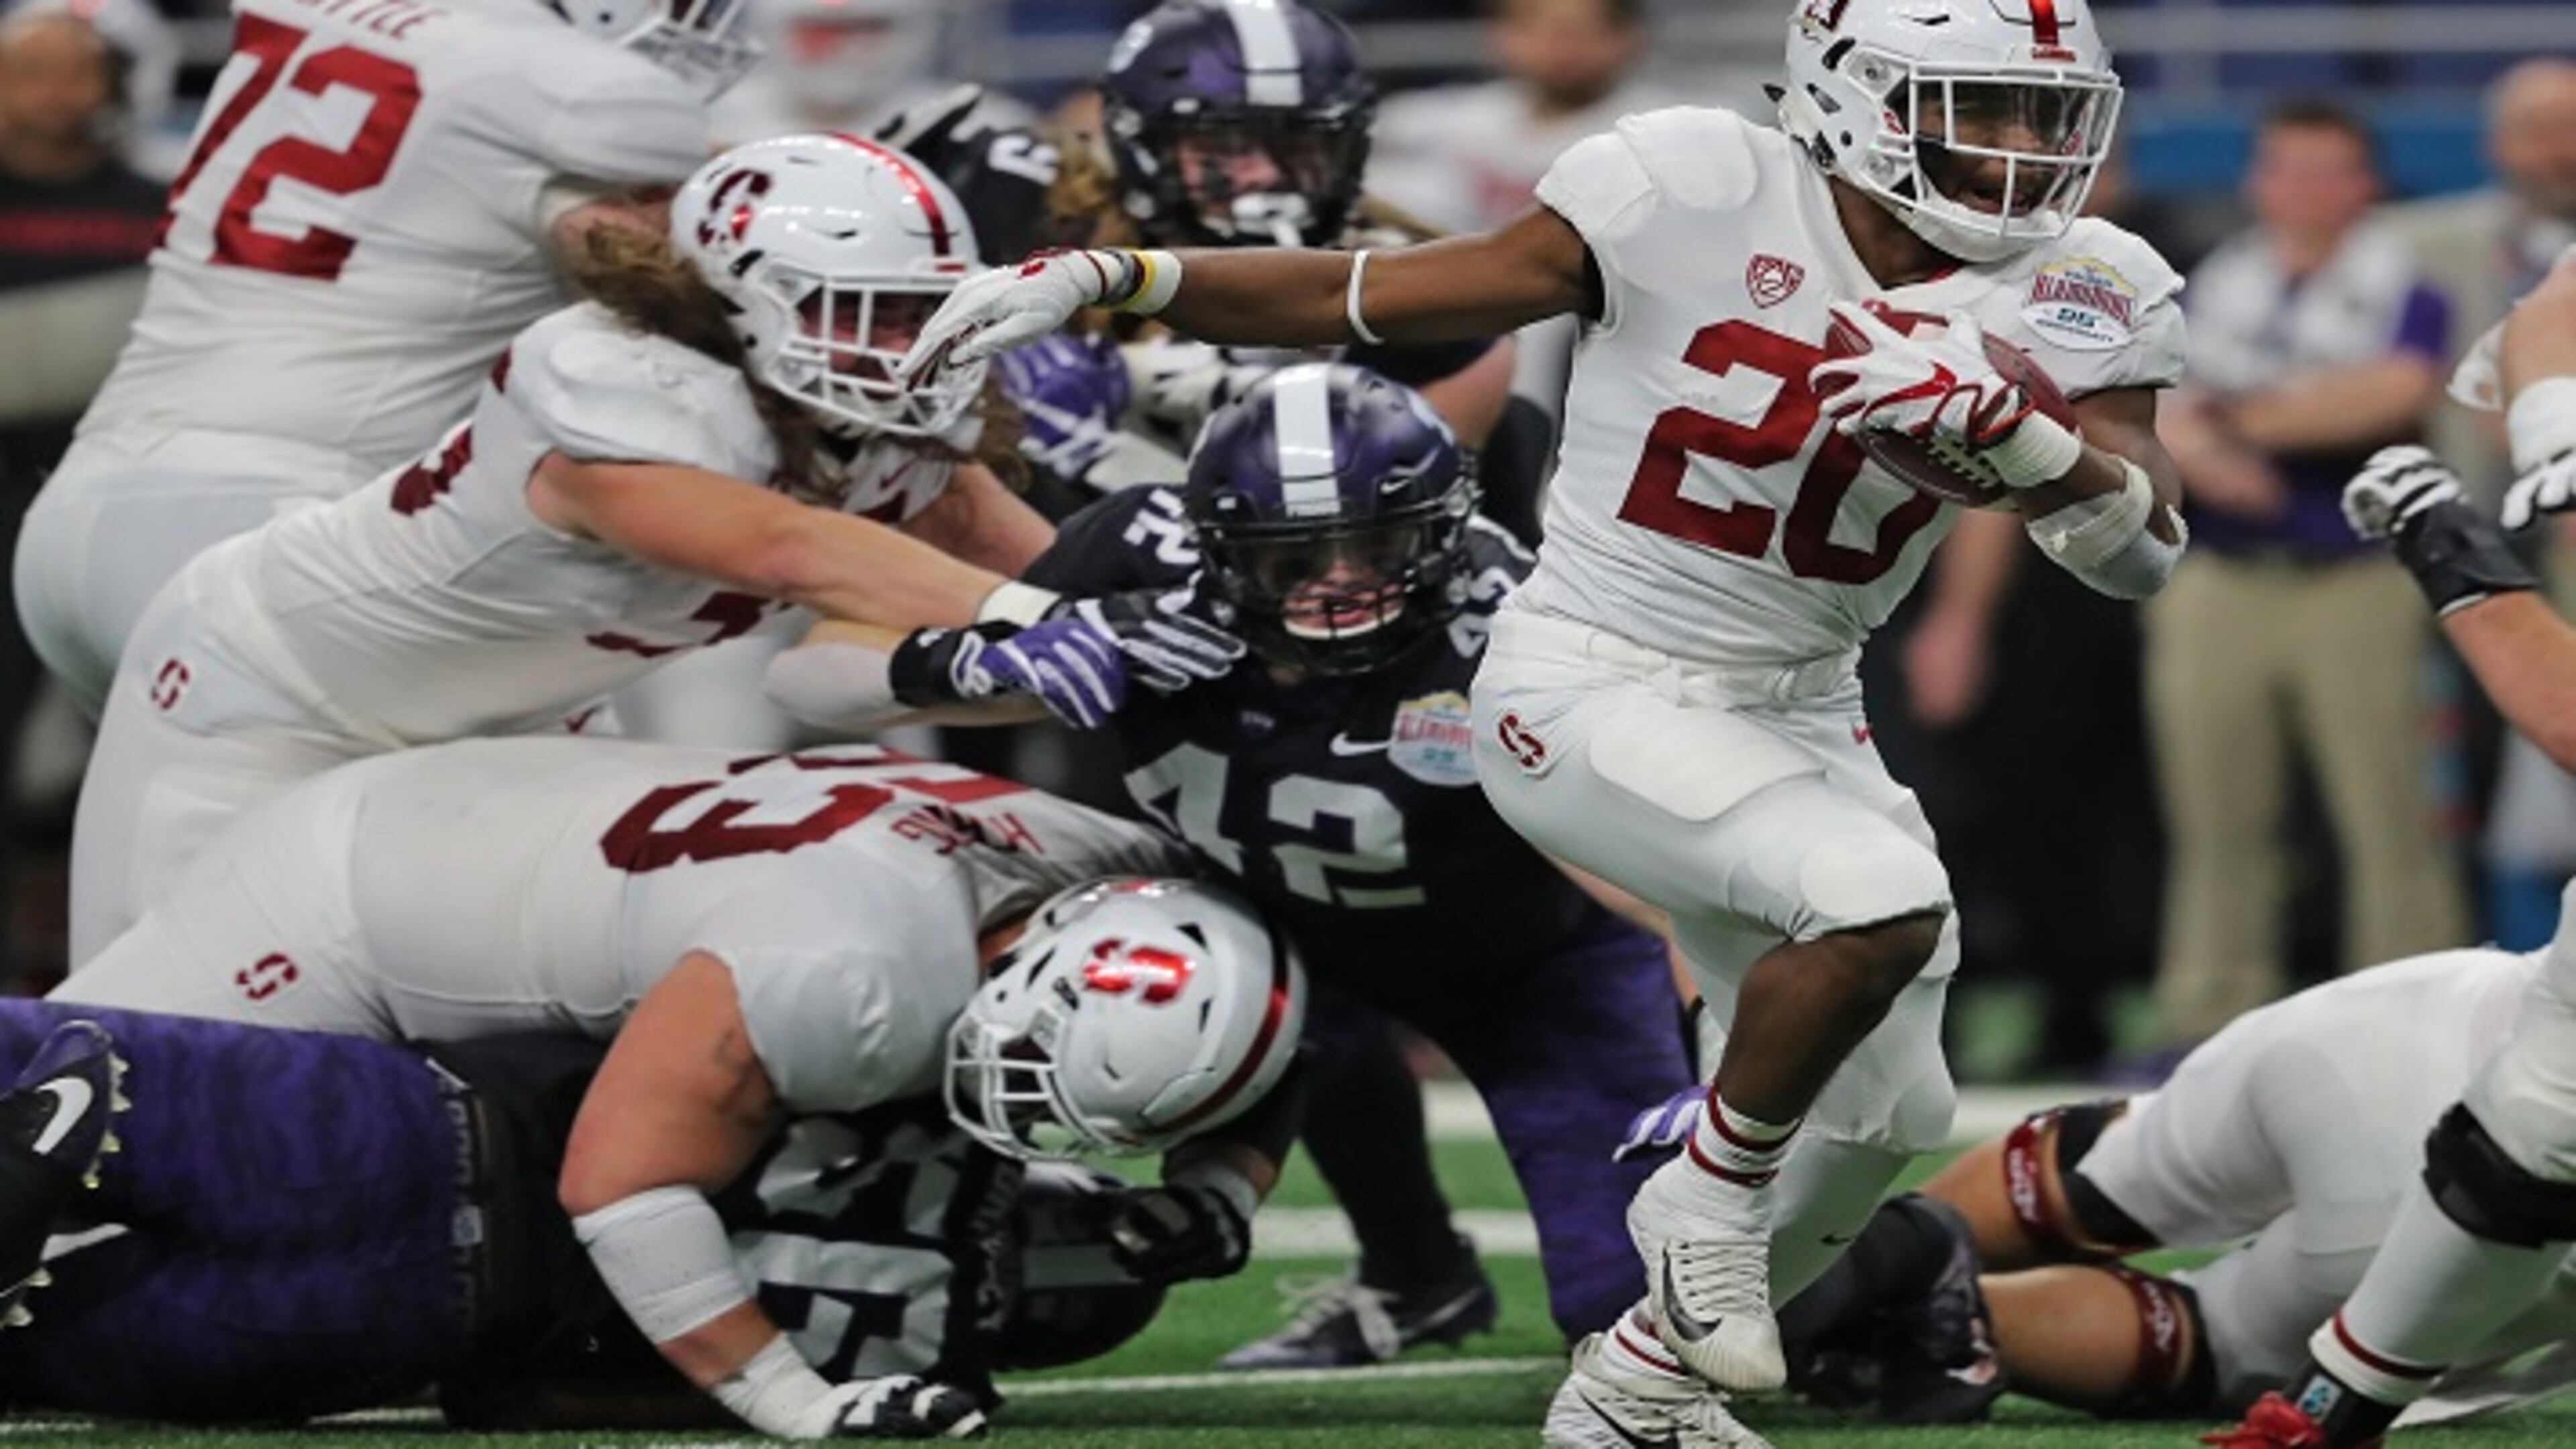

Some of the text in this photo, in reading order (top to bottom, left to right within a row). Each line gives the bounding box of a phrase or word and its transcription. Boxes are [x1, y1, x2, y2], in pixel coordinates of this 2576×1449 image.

[149, 11, 423, 282] 72
[1615, 319, 1943, 585] 20
[1124, 742, 1426, 908] 42
